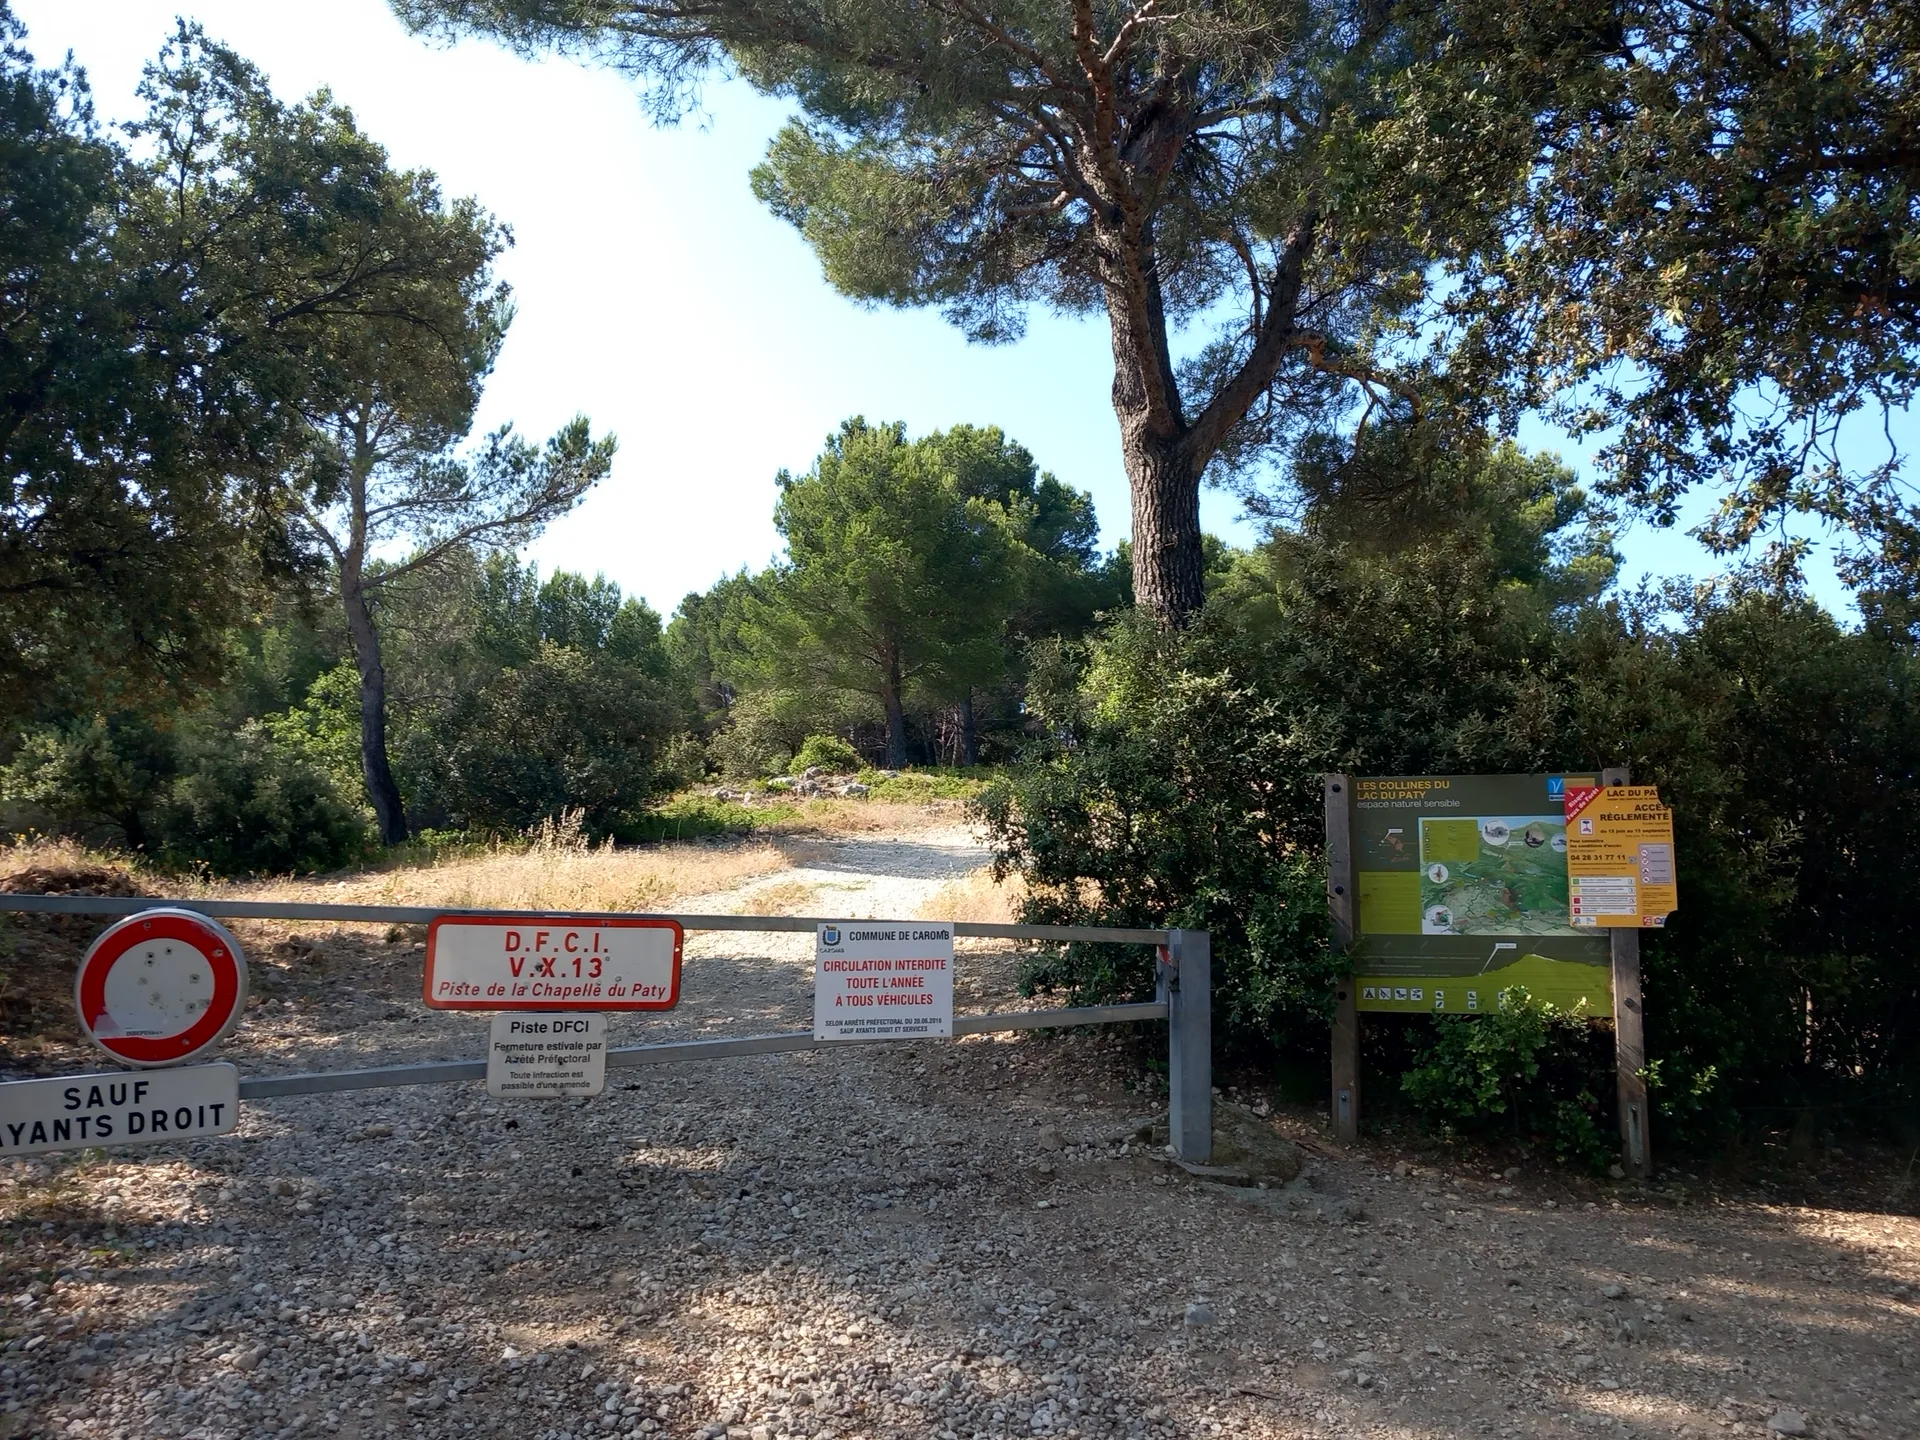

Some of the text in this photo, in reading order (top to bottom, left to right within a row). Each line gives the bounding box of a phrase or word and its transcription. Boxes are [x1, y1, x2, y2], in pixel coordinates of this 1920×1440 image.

[1357, 781, 1450, 790] LES COLLINES DU
[1357, 791, 1426, 800] LAC DU PATY
[1568, 791, 1586, 808] Risque
[1357, 799, 1460, 809] espace naturel sensible
[1578, 801, 1587, 809] de
[849, 930, 950, 941] COMMUNE DE CAROMB
[505, 931, 608, 953] D.F.C.I.
[510, 957, 602, 978] V.X.13
[823, 959, 946, 972] CIRCULATION INTERDITE
[846, 975, 924, 989] TOUTE L'ANNÉE
[438, 982, 667, 1000] Piste de la Chapelle du Paty
[835, 992, 933, 1007] À TOUS VÉHICULES
[510, 1020, 589, 1033] Piste DFCI
[844, 1018, 865, 1026] ARRÊTÉ
[866, 1018, 903, 1026] PRÉFECTORAL
[840, 1027, 854, 1035] SAUF
[494, 1041, 602, 1052] Fermeture estivale par
[537, 1054, 591, 1064] Préfectoral
[510, 1071, 531, 1079] Toute
[533, 1071, 570, 1079] infraction
[501, 1081, 590, 1091] passible d'une amende
[63, 1081, 149, 1110] SAUF
[0, 1103, 225, 1147] YANTS DROIT
